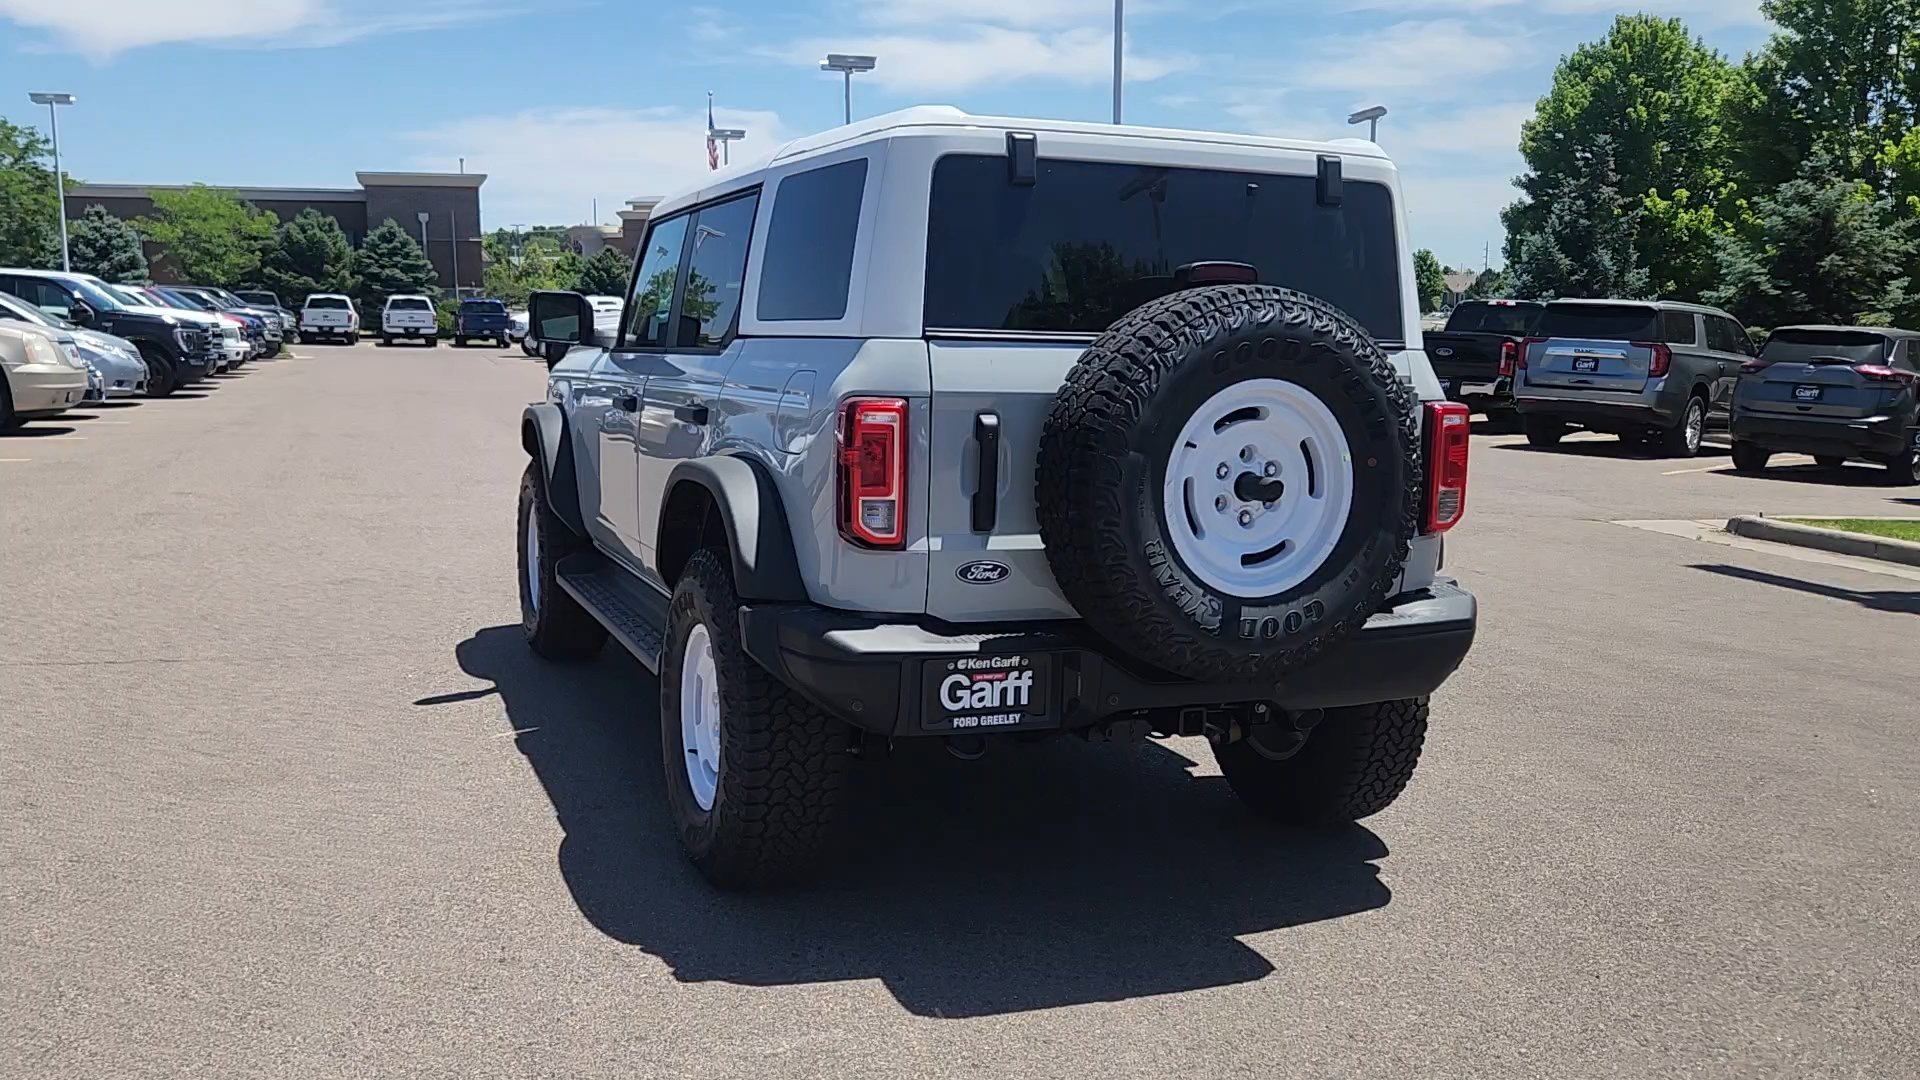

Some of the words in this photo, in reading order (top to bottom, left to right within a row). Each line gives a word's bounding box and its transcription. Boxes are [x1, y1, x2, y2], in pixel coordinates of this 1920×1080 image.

[1576, 360, 1596, 369] Garff
[1795, 388, 1820, 397] Garff
[966, 564, 1002, 579] Ford
[967, 657, 990, 669] Ken
[991, 655, 1020, 668] Garff
[939, 670, 1033, 711] Garff
[953, 716, 978, 728] FORD
[980, 713, 1021, 726] GREELEY
